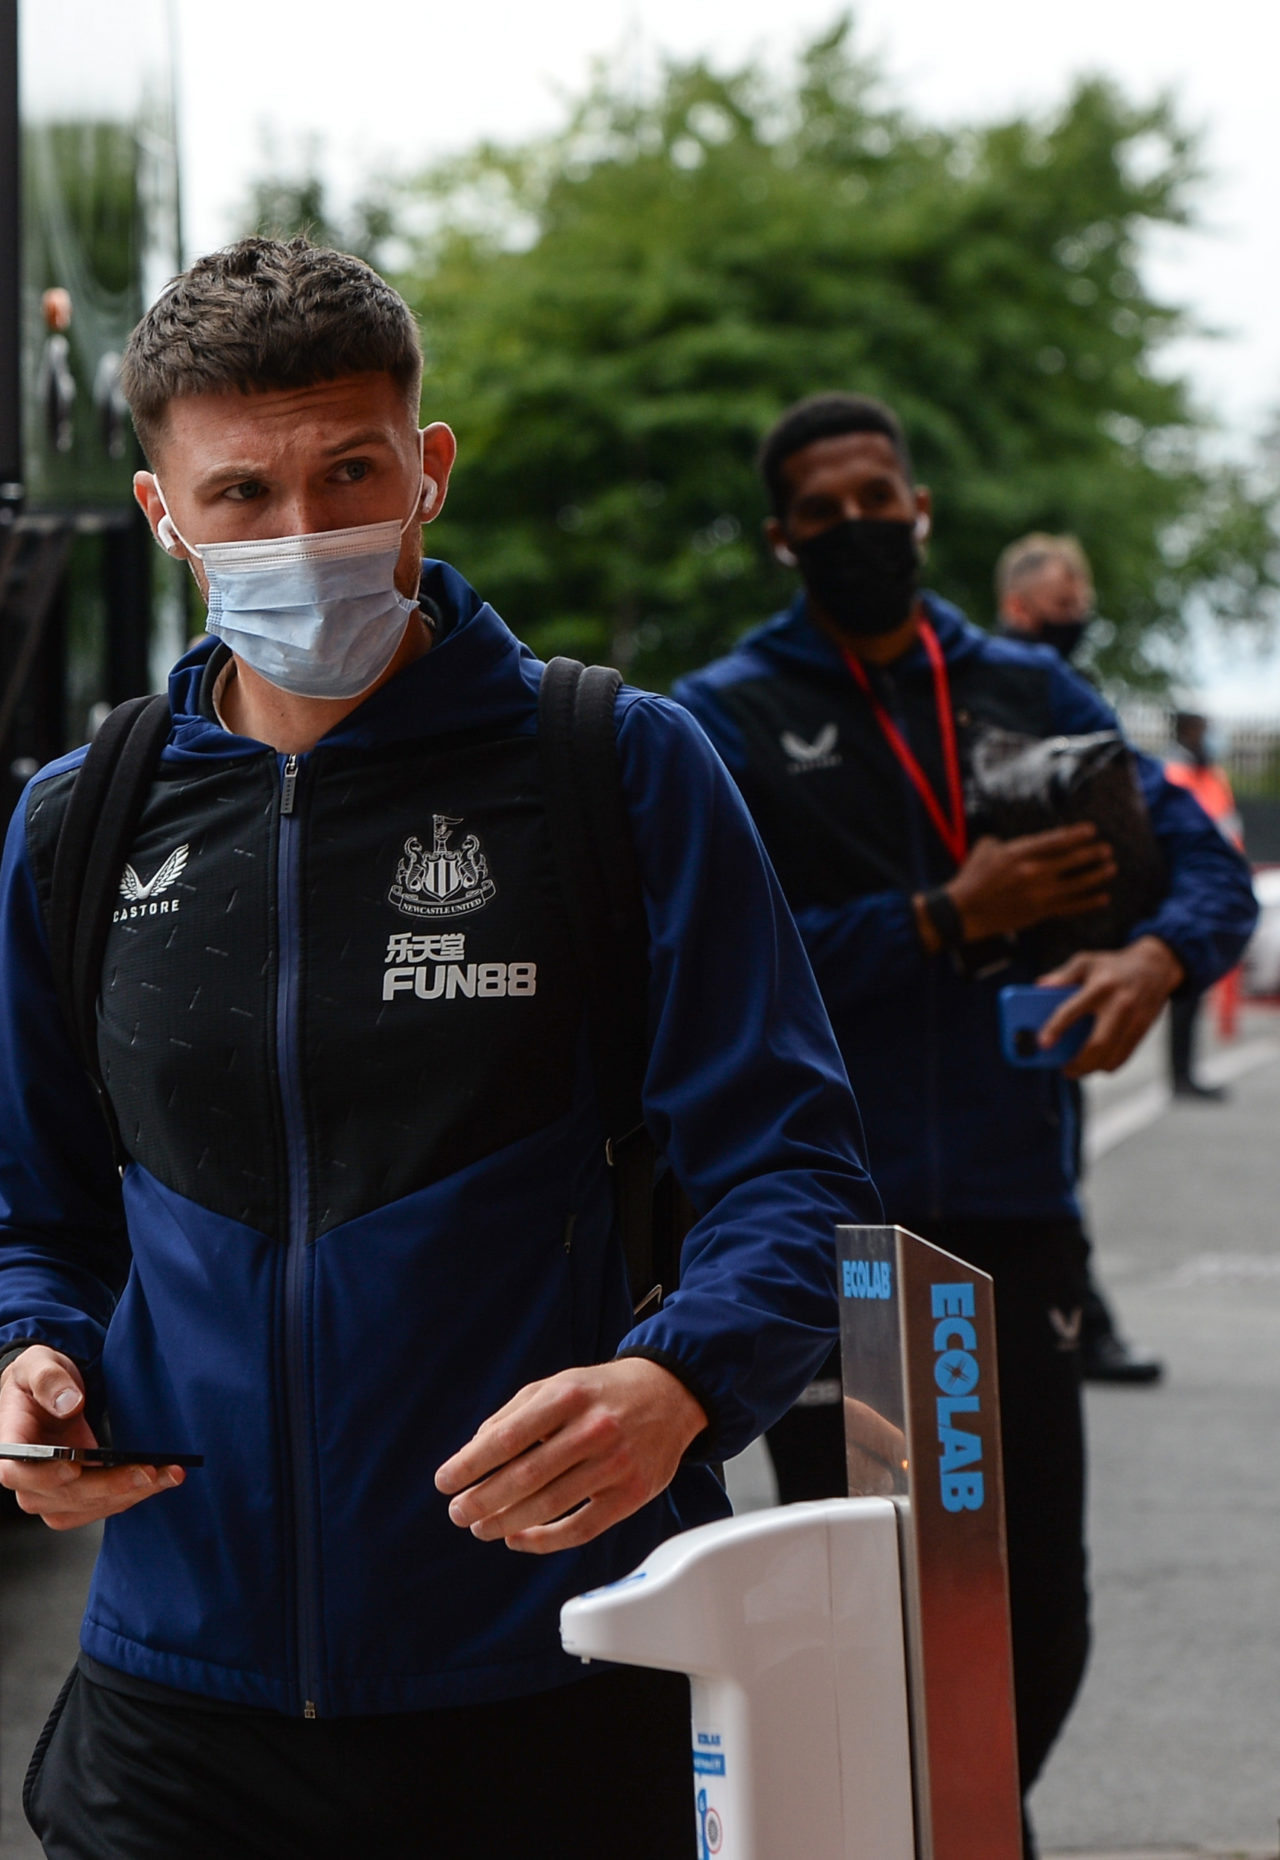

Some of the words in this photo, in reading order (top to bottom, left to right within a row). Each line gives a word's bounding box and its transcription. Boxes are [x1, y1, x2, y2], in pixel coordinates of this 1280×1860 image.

[112, 899, 180, 923] CASTORE
[402, 902, 450, 915] NEWCASTLE
[451, 898, 482, 912] UNITED
[384, 931, 466, 964] 乐天堂
[382, 961, 538, 1001] FUN88
[842, 1260, 892, 1300] ECOLAB
[931, 1283, 984, 1513] ECOLAB
